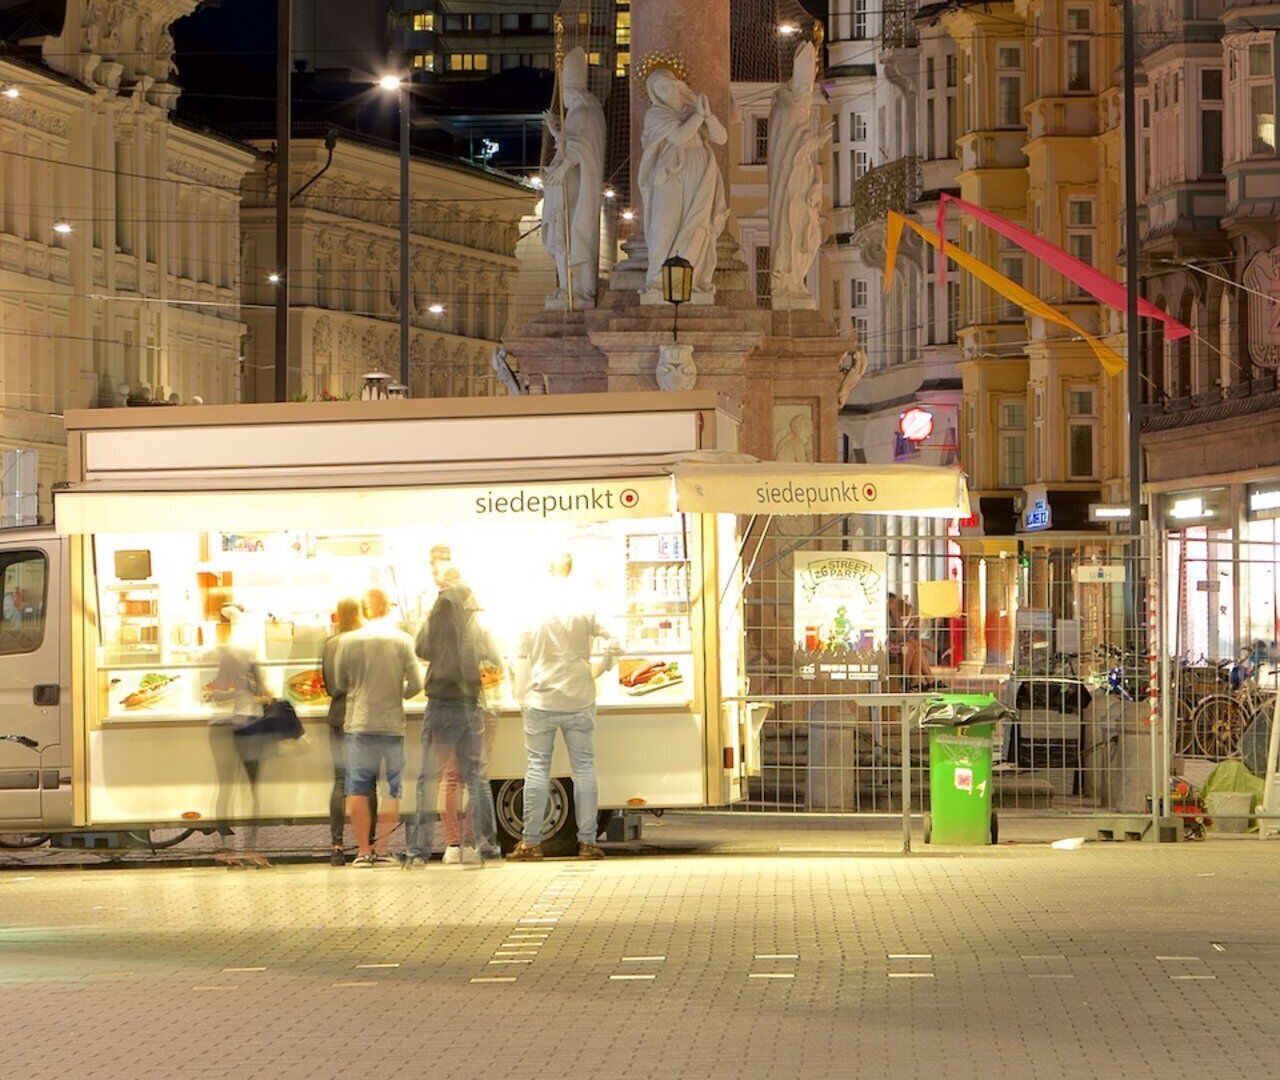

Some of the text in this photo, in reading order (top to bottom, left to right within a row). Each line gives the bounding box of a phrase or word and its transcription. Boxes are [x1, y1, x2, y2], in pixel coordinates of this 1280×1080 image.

[475, 487, 614, 518] siedepunkt
[756, 480, 860, 509] siedepunkt
[828, 560, 869, 573] STREET
[830, 569, 866, 580] PARTY
